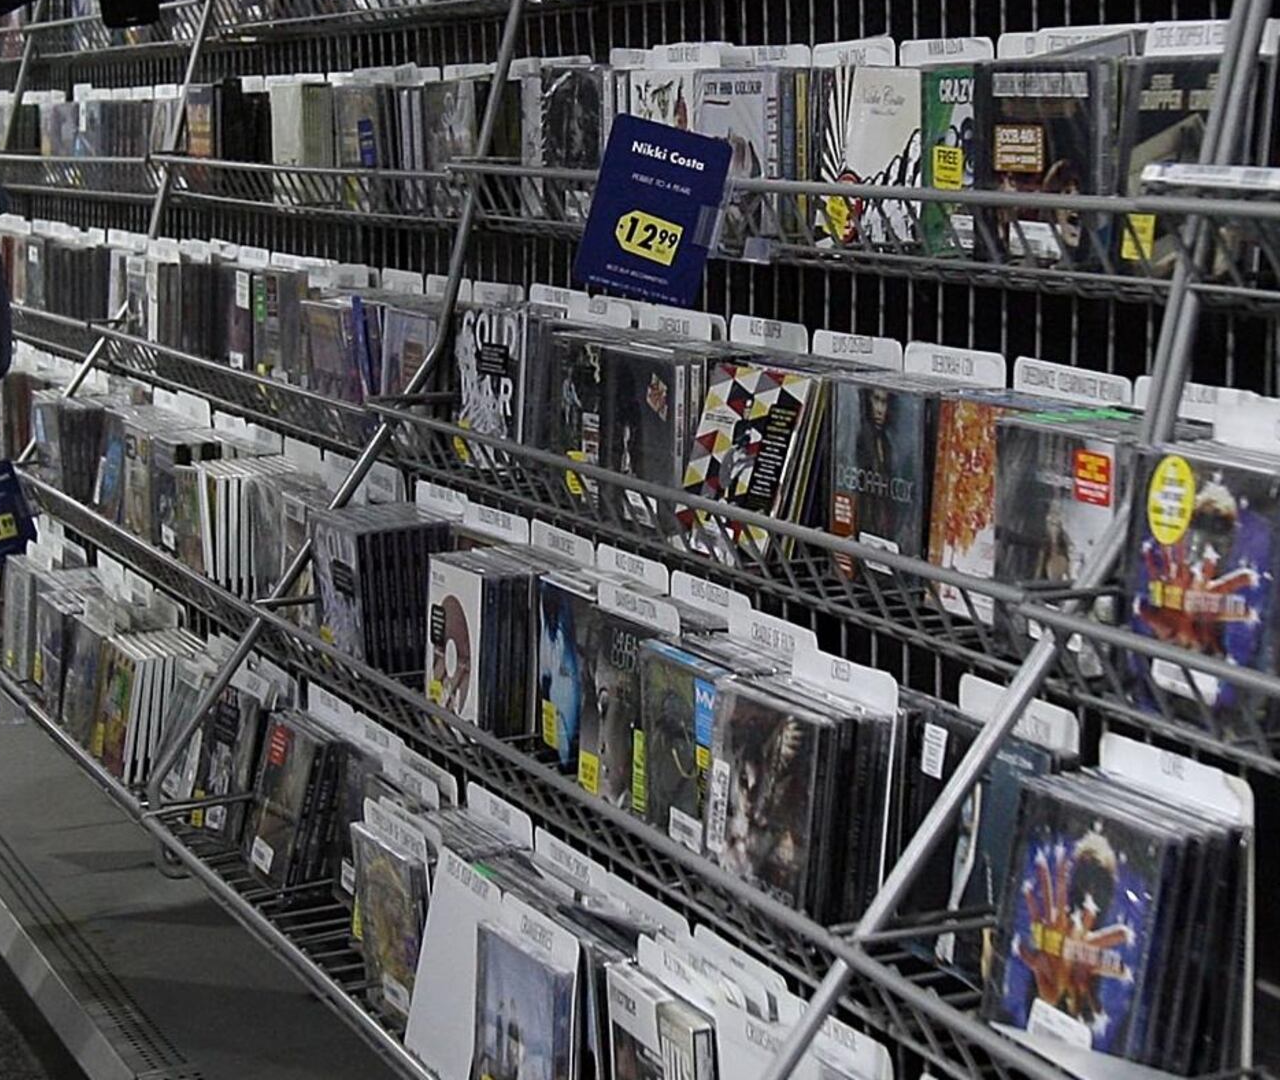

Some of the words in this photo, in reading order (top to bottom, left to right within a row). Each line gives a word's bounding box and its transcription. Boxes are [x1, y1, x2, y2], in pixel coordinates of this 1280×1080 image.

[938, 78, 976, 104] CRAZY
[631, 140, 667, 160] Nikki
[669, 152, 705, 171] Costa
[937, 149, 958, 165] FREE
